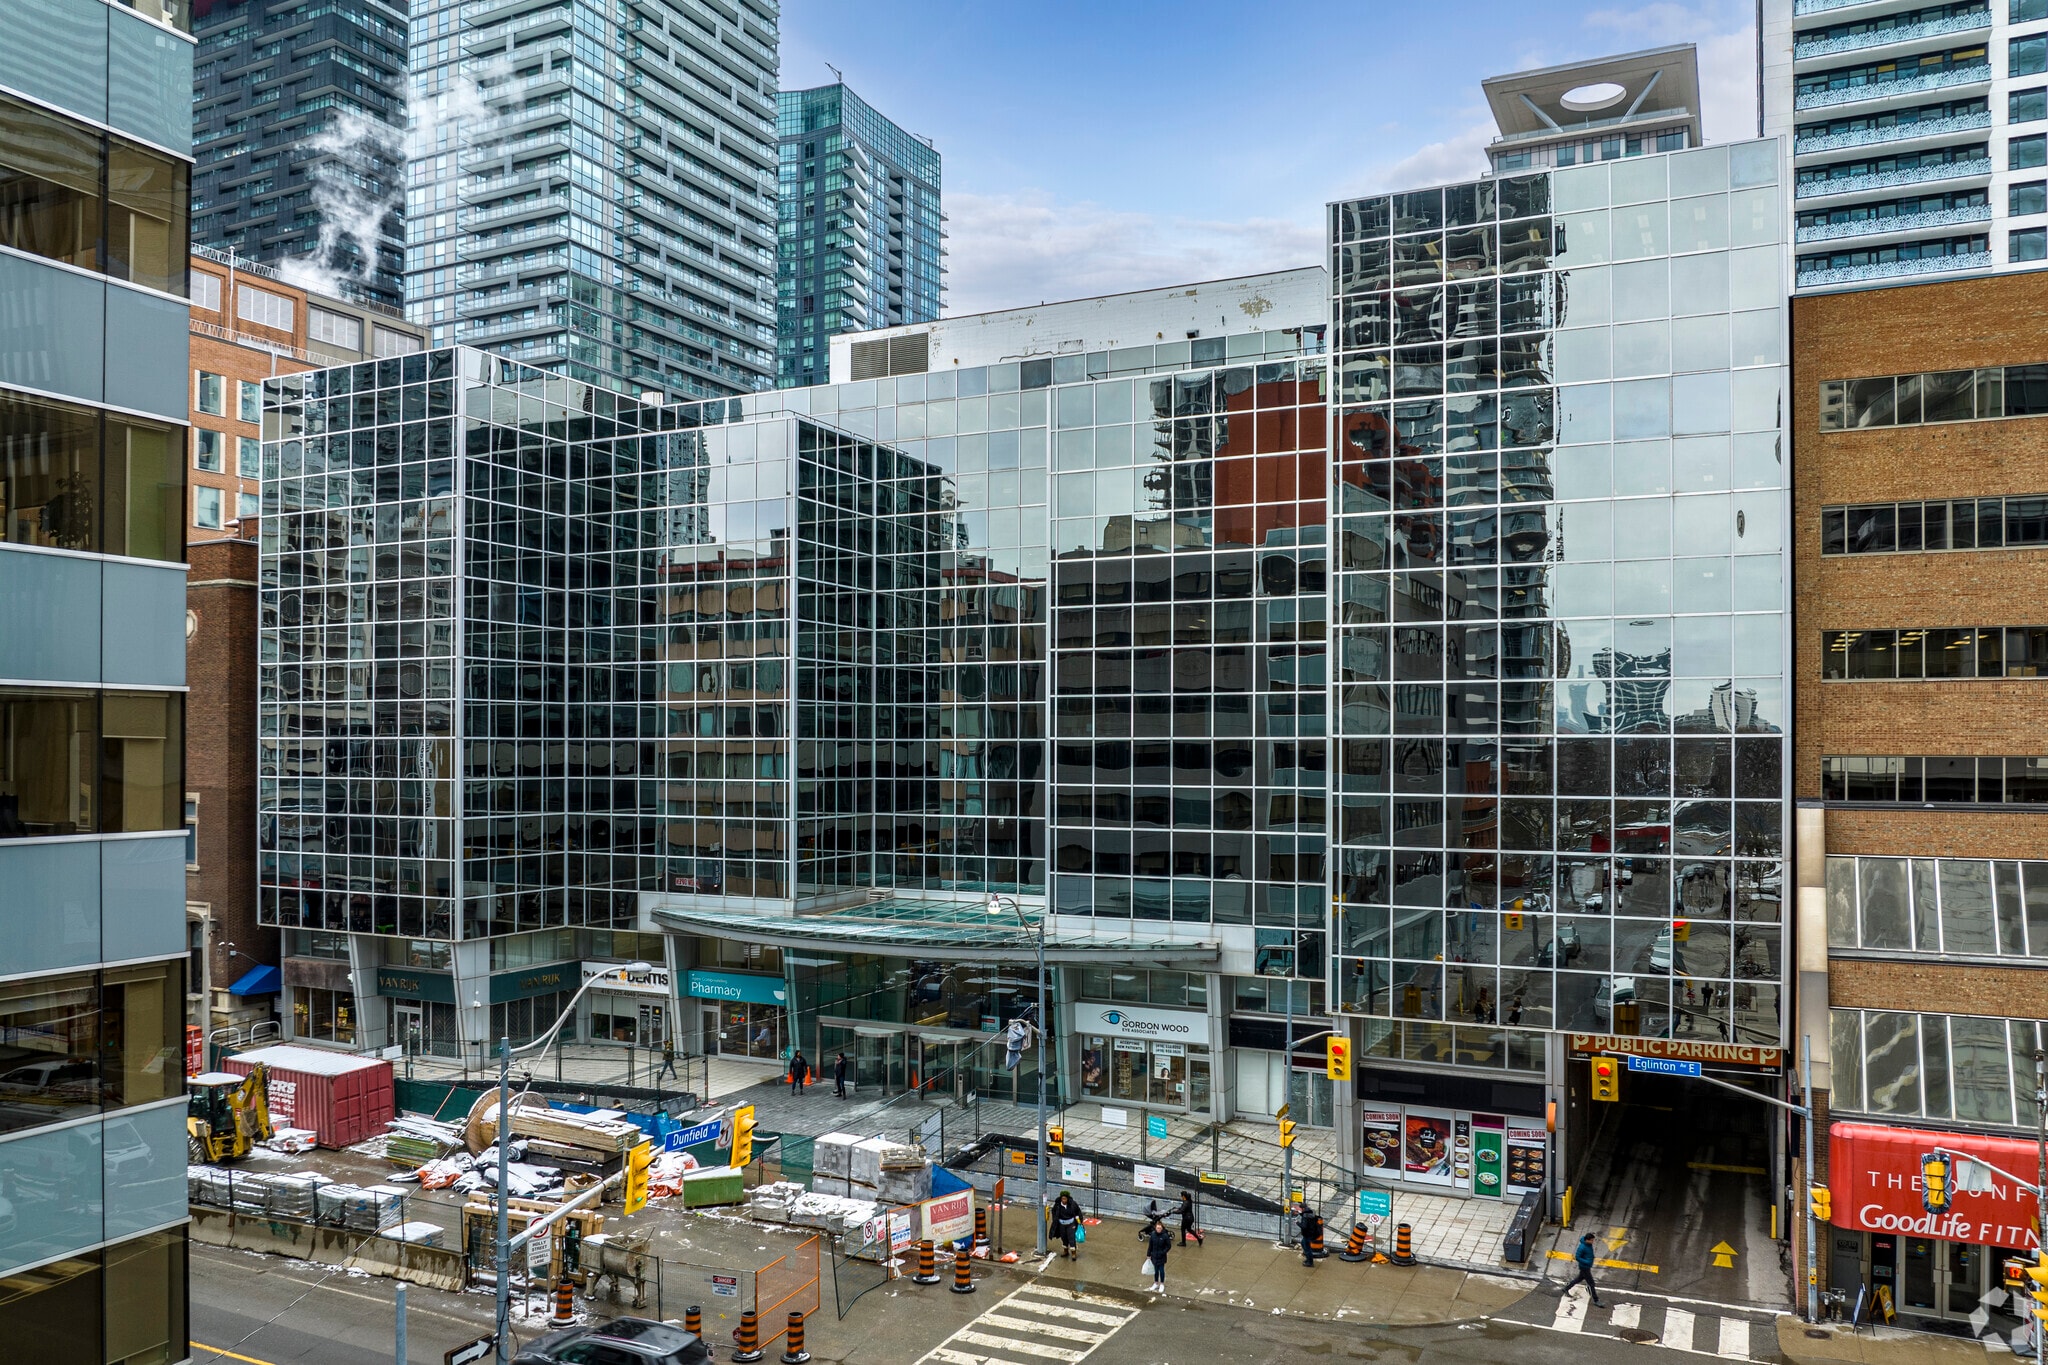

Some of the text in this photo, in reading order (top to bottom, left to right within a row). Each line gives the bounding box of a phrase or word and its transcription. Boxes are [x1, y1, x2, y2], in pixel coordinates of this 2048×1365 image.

[379, 976, 420, 991] VAN RIJK
[519, 973, 561, 988] VAN RIJK
[691, 982, 742, 999] Pharmacy
[1122, 1020, 1190, 1033] GORDON WOOD
[1594, 1035, 1663, 1055] PUBLIC
[1666, 1041, 1754, 1062] PARKING
[1635, 1058, 1676, 1071] Eglinton
[1688, 1063, 1695, 1073] E
[1365, 1112, 1399, 1121] COMING SOON
[672, 1126, 709, 1146] Dunfield
[1867, 1170, 1922, 1192] THE
[932, 1199, 967, 1214] VAN RIJK
[1859, 1204, 1972, 1239] GoodLife
